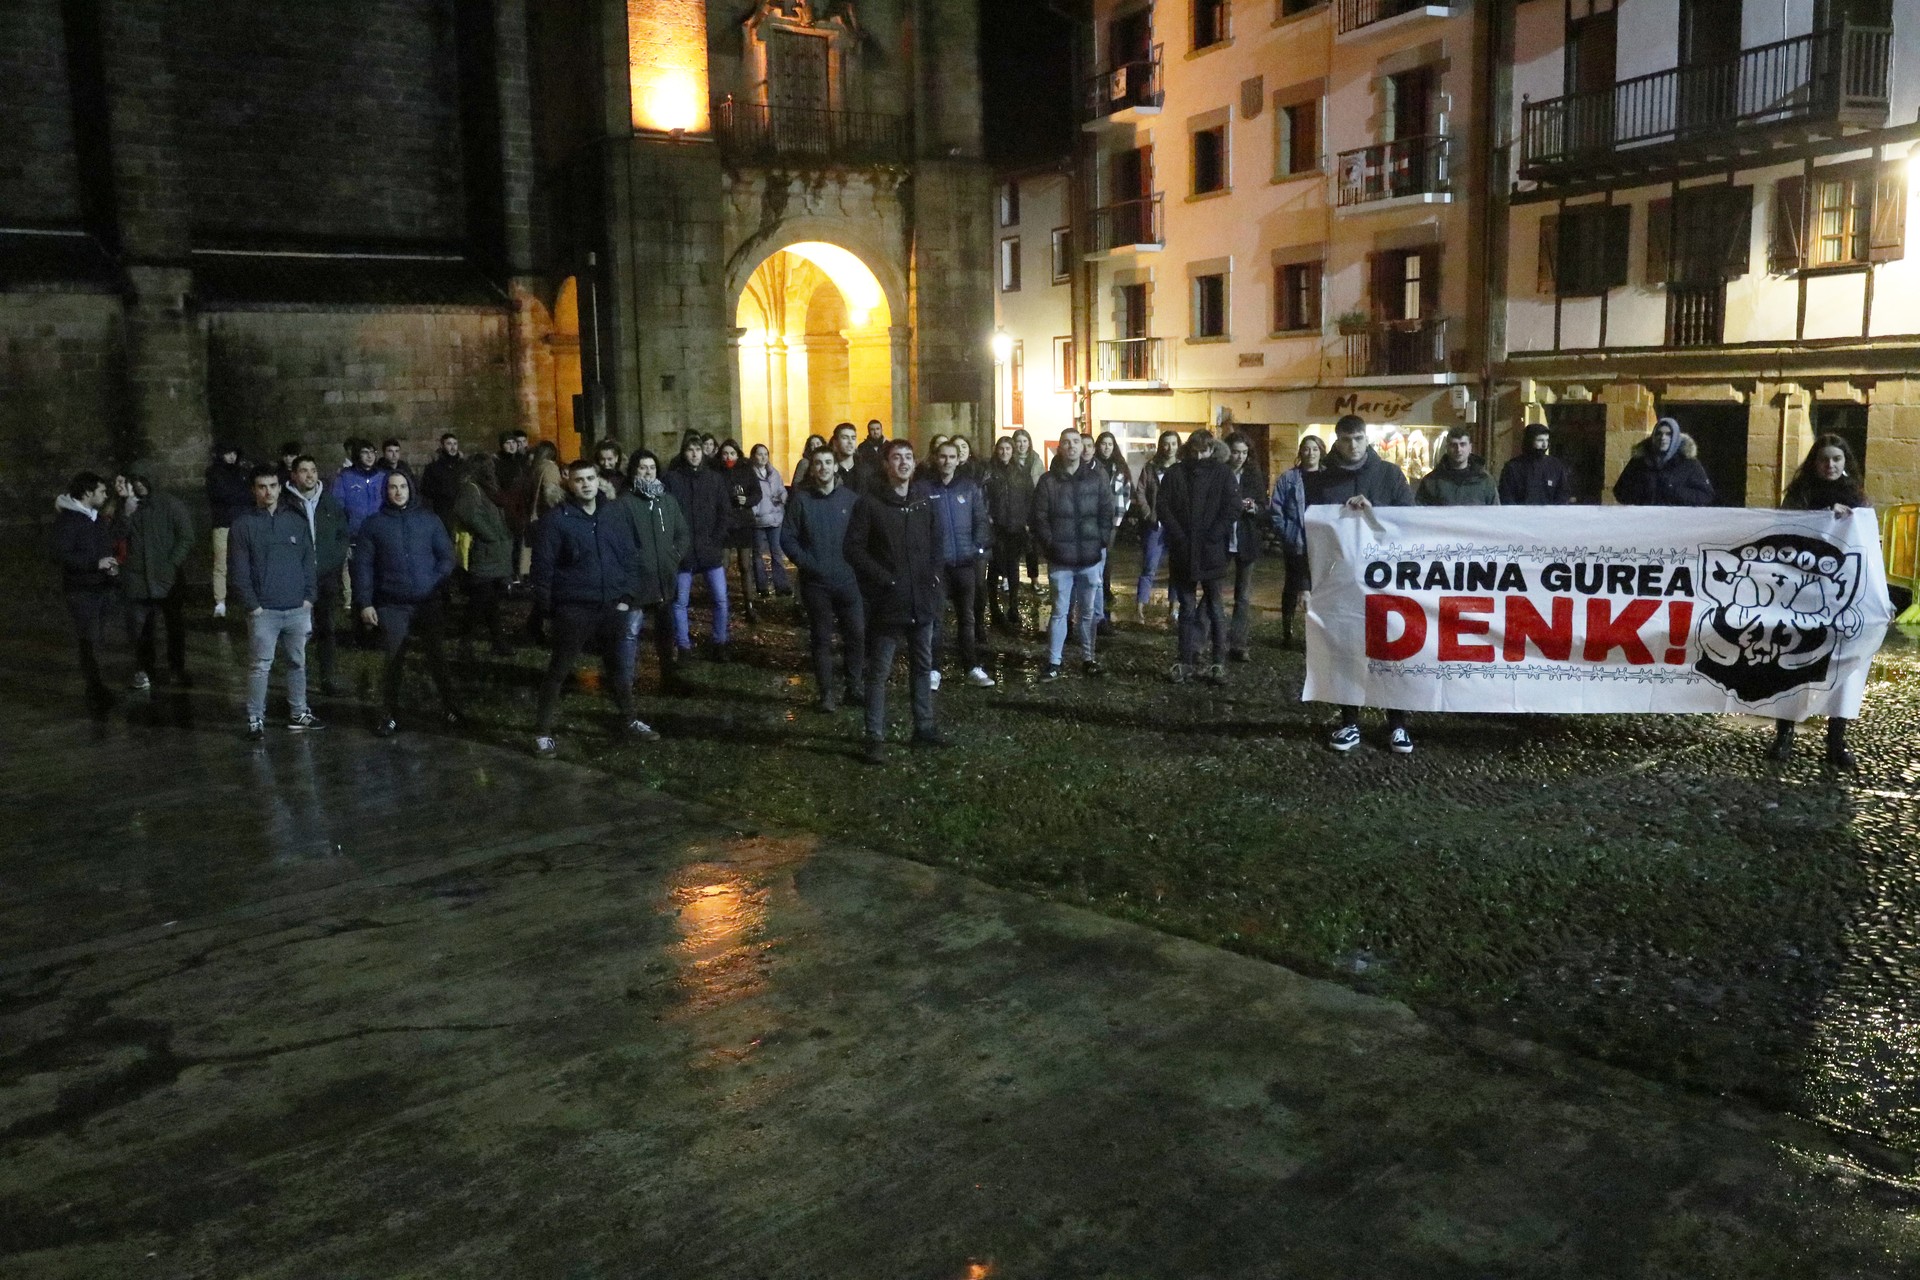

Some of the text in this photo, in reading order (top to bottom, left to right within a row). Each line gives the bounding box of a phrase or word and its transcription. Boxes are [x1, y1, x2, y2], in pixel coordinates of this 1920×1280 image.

[1335, 393, 1413, 418] Marije
[1364, 561, 1695, 597] ORAINA GUREA
[1365, 594, 1695, 665] DENK!
